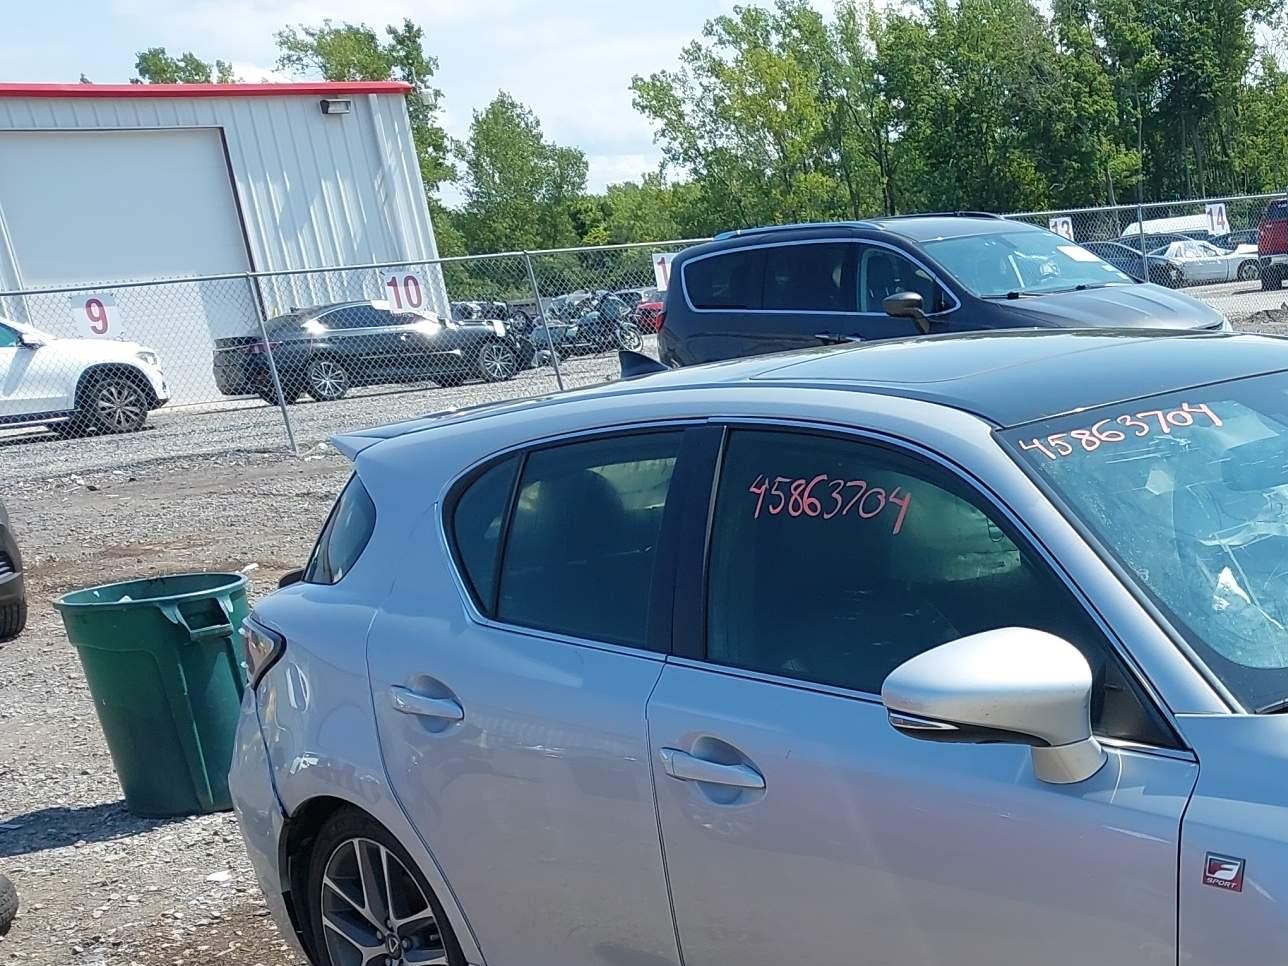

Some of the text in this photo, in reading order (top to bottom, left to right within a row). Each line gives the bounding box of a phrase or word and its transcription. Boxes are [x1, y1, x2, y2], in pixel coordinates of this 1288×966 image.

[1206, 205, 1225, 230] 14
[386, 275, 422, 309] 10
[85, 298, 108, 334] 9
[1018, 402, 1224, 460] 45863704
[749, 474, 912, 535] 45863704
[1206, 877, 1238, 888] SPORT
